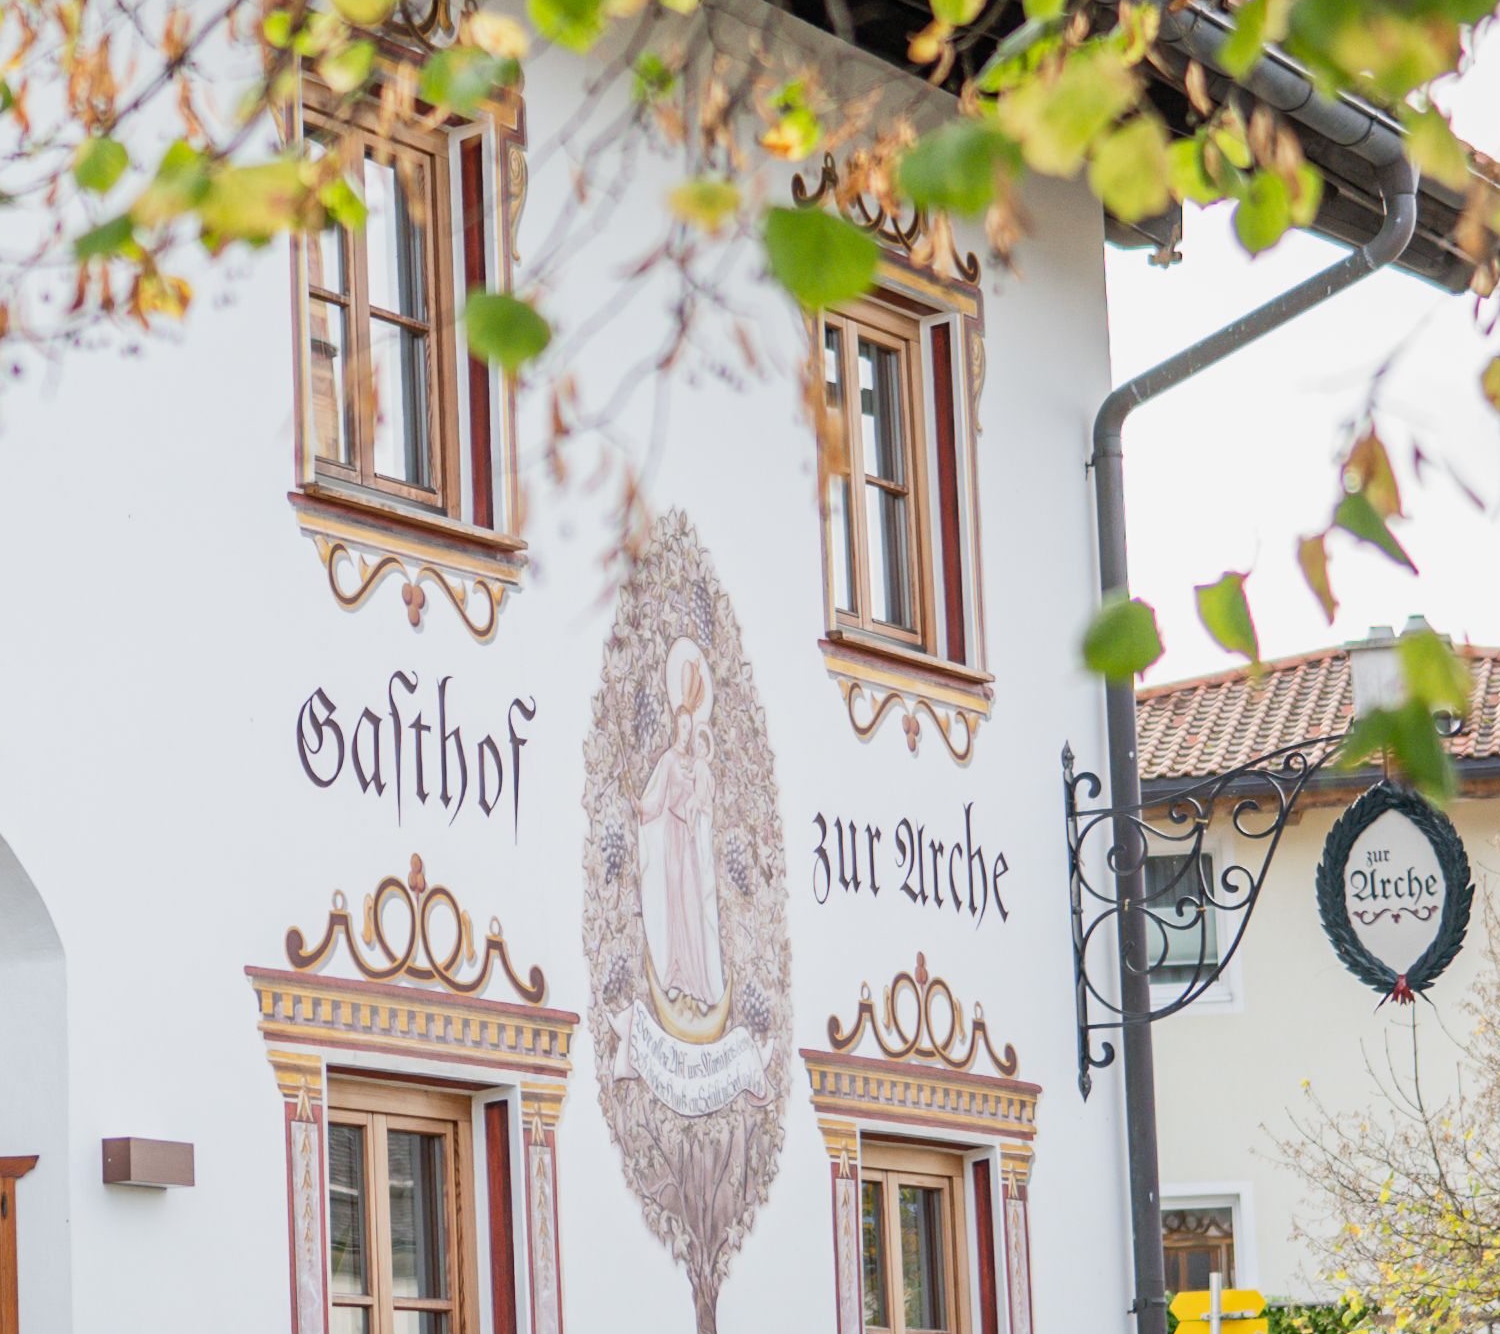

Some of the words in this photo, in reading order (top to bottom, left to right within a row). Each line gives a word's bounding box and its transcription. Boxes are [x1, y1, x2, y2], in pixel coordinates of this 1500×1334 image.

[297, 670, 536, 845] Gasthof
[812, 812, 881, 904] zur
[895, 801, 1009, 930] Arche
[1366, 850, 1390, 867] zur
[1350, 867, 1437, 906] Arche
